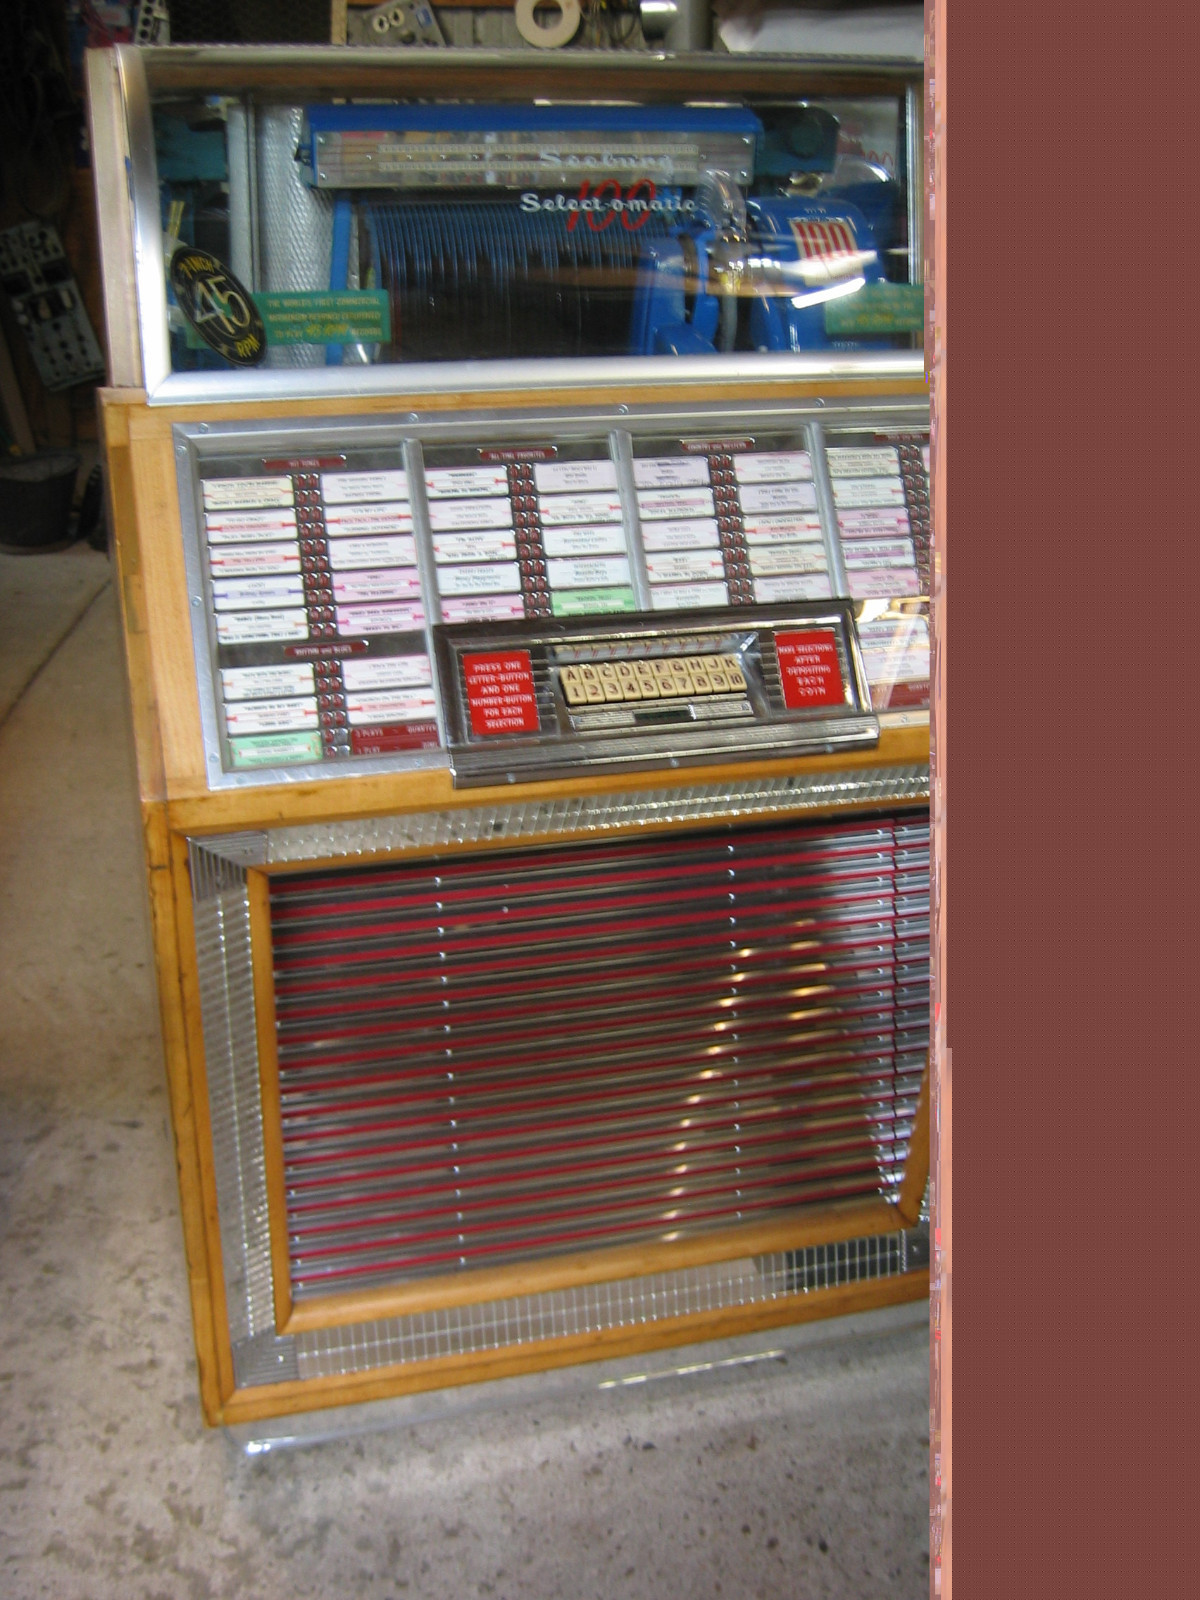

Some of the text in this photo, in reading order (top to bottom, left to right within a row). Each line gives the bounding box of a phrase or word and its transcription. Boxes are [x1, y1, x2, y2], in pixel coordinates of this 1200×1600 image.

[539, 150, 674, 177] Seeburg
[566, 178, 656, 232] 100
[195, 275, 251, 335] 45
[235, 333, 260, 358] RPM
[473, 660, 521, 673] PRESS ONE
[567, 656, 736, 682] A B C D E F G H J K
[794, 655, 821, 665] AFTER
[481, 683, 520, 695] AND ONE
[590, 684, 599, 696] 2
[609, 683, 618, 694] 3
[627, 682, 636, 694] 4
[644, 680, 654, 692] 5
[662, 679, 671, 690] 6
[679, 678, 687, 690] 7
[697, 676, 706, 687] 8
[714, 674, 724, 686] 9
[731, 673, 743, 686] 10
[796, 675, 825, 686] EACH
[799, 686, 826, 696] COIN
[483, 706, 523, 717] FOR EACH
